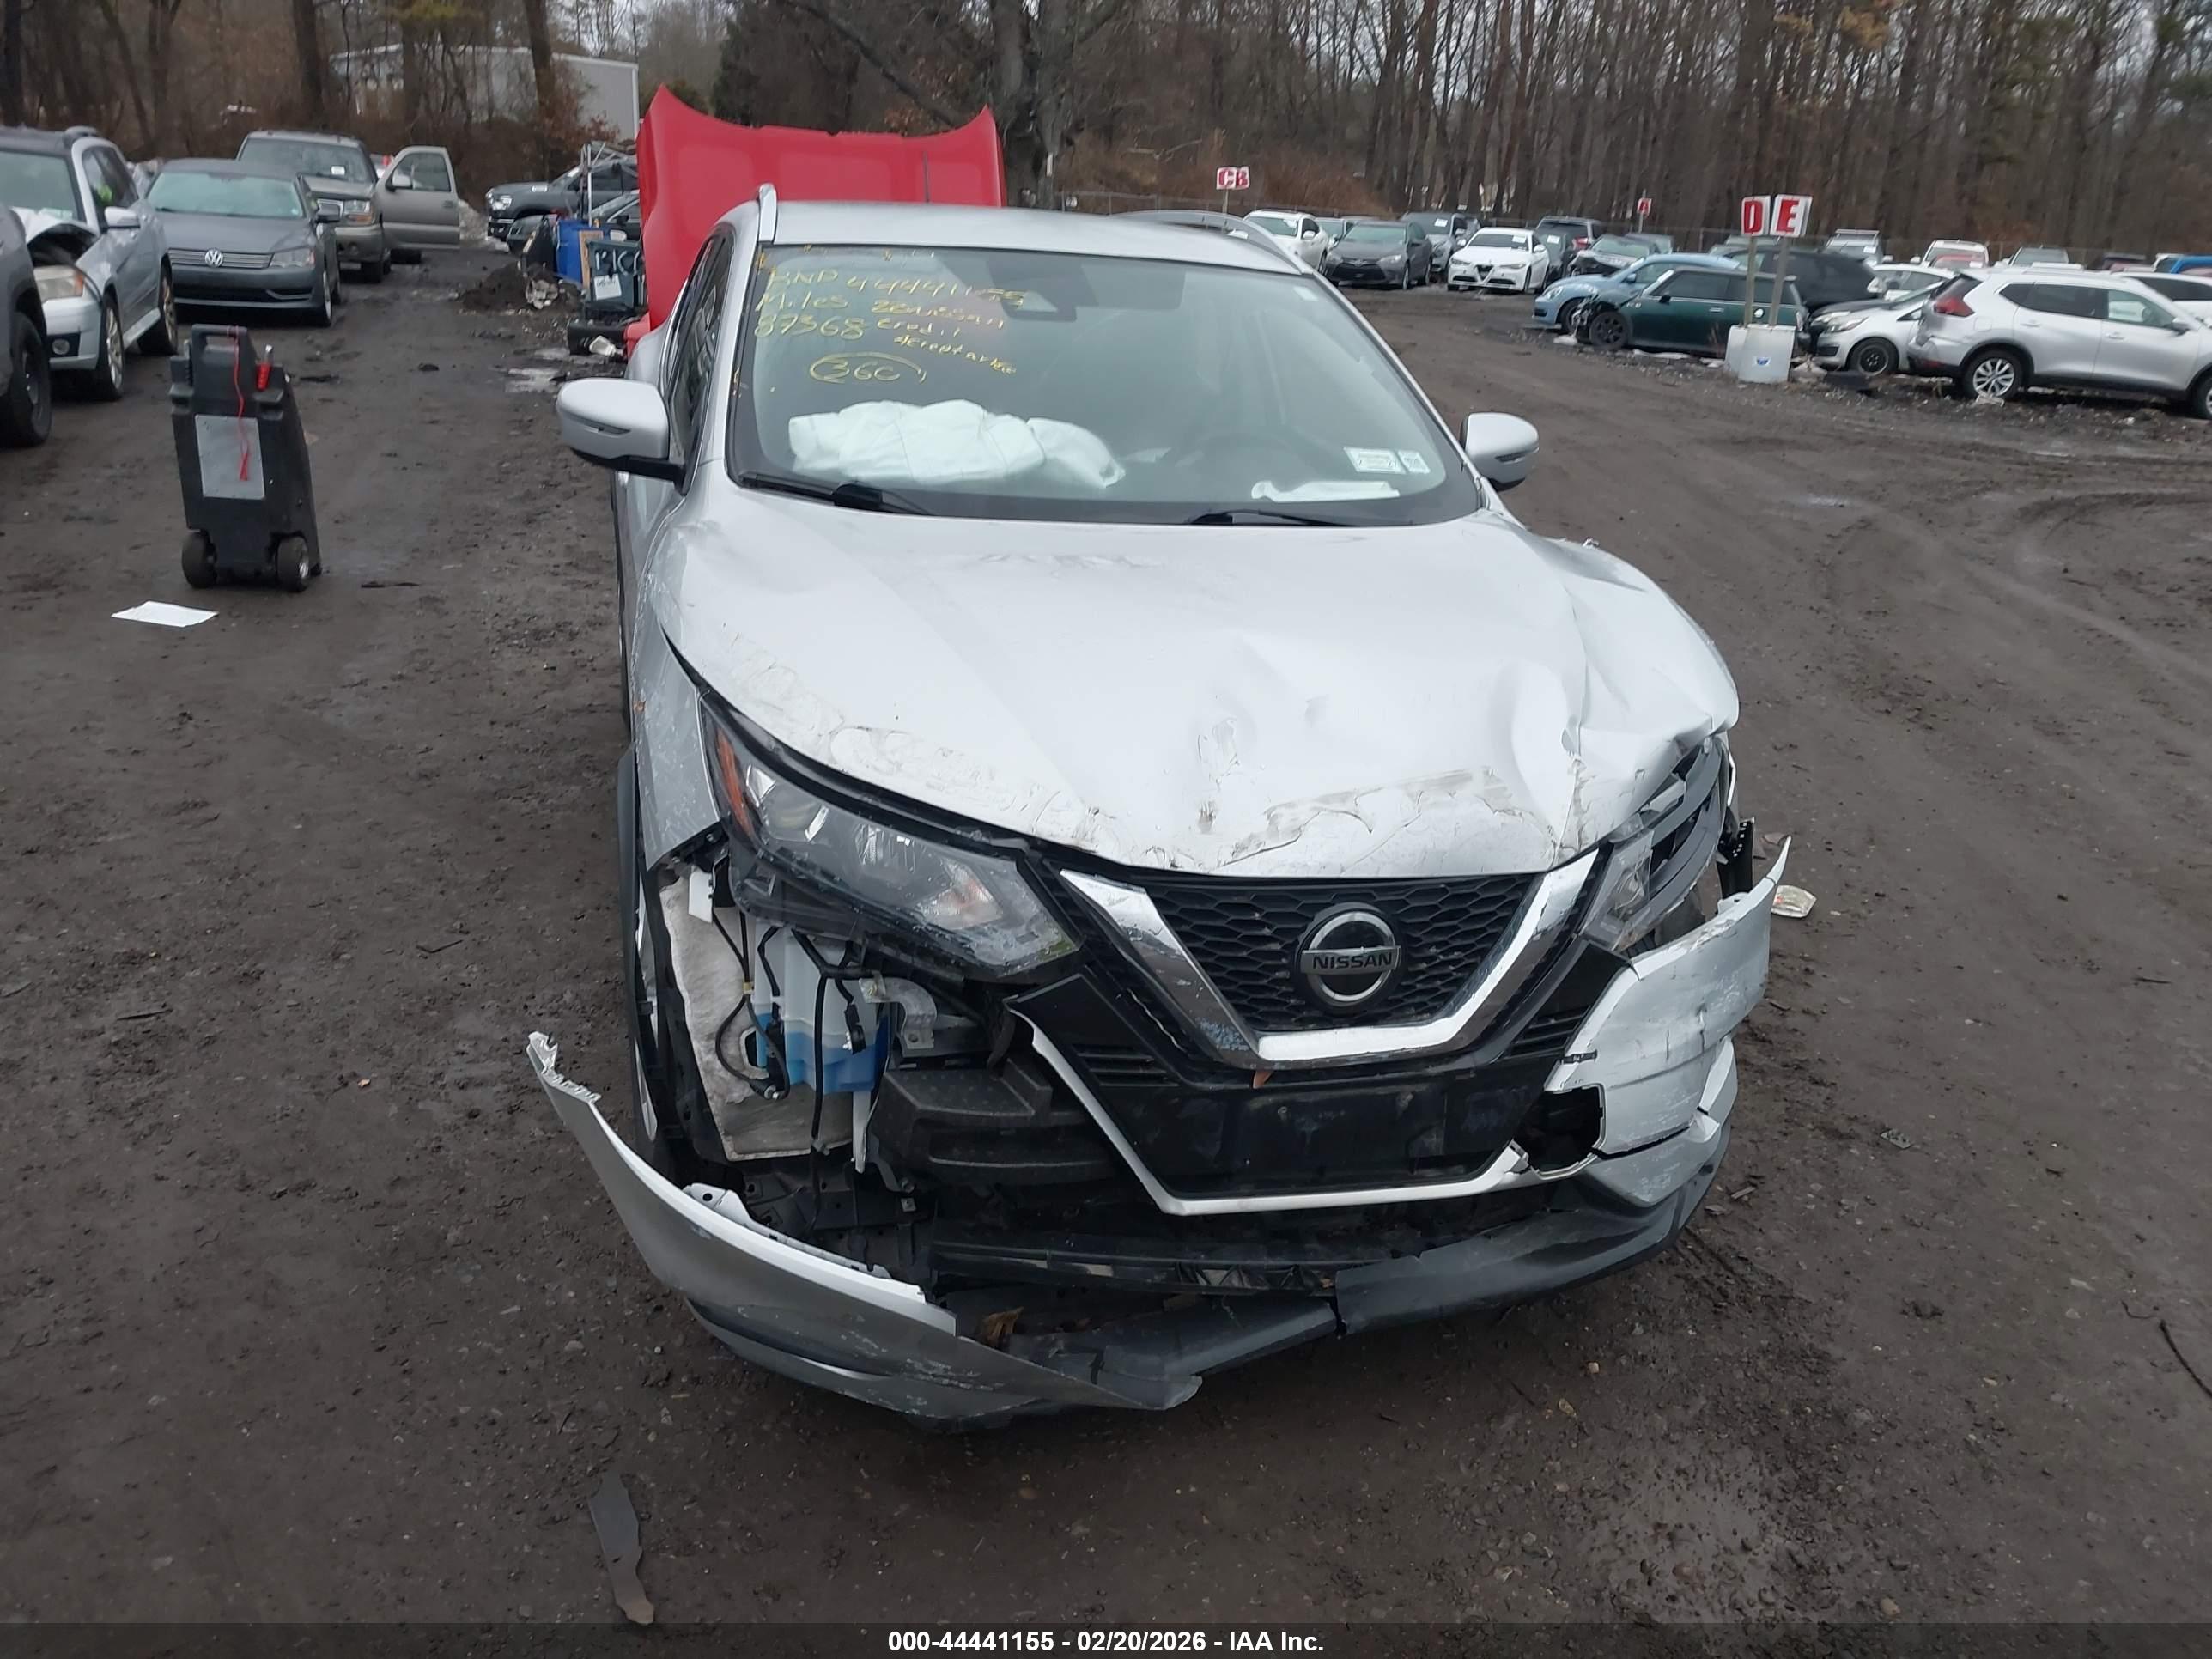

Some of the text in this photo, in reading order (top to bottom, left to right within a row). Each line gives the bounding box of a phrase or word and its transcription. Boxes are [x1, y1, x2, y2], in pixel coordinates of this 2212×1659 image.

[1743, 198, 1800, 234] D E
[1312, 952, 1393, 969] NISSAN
